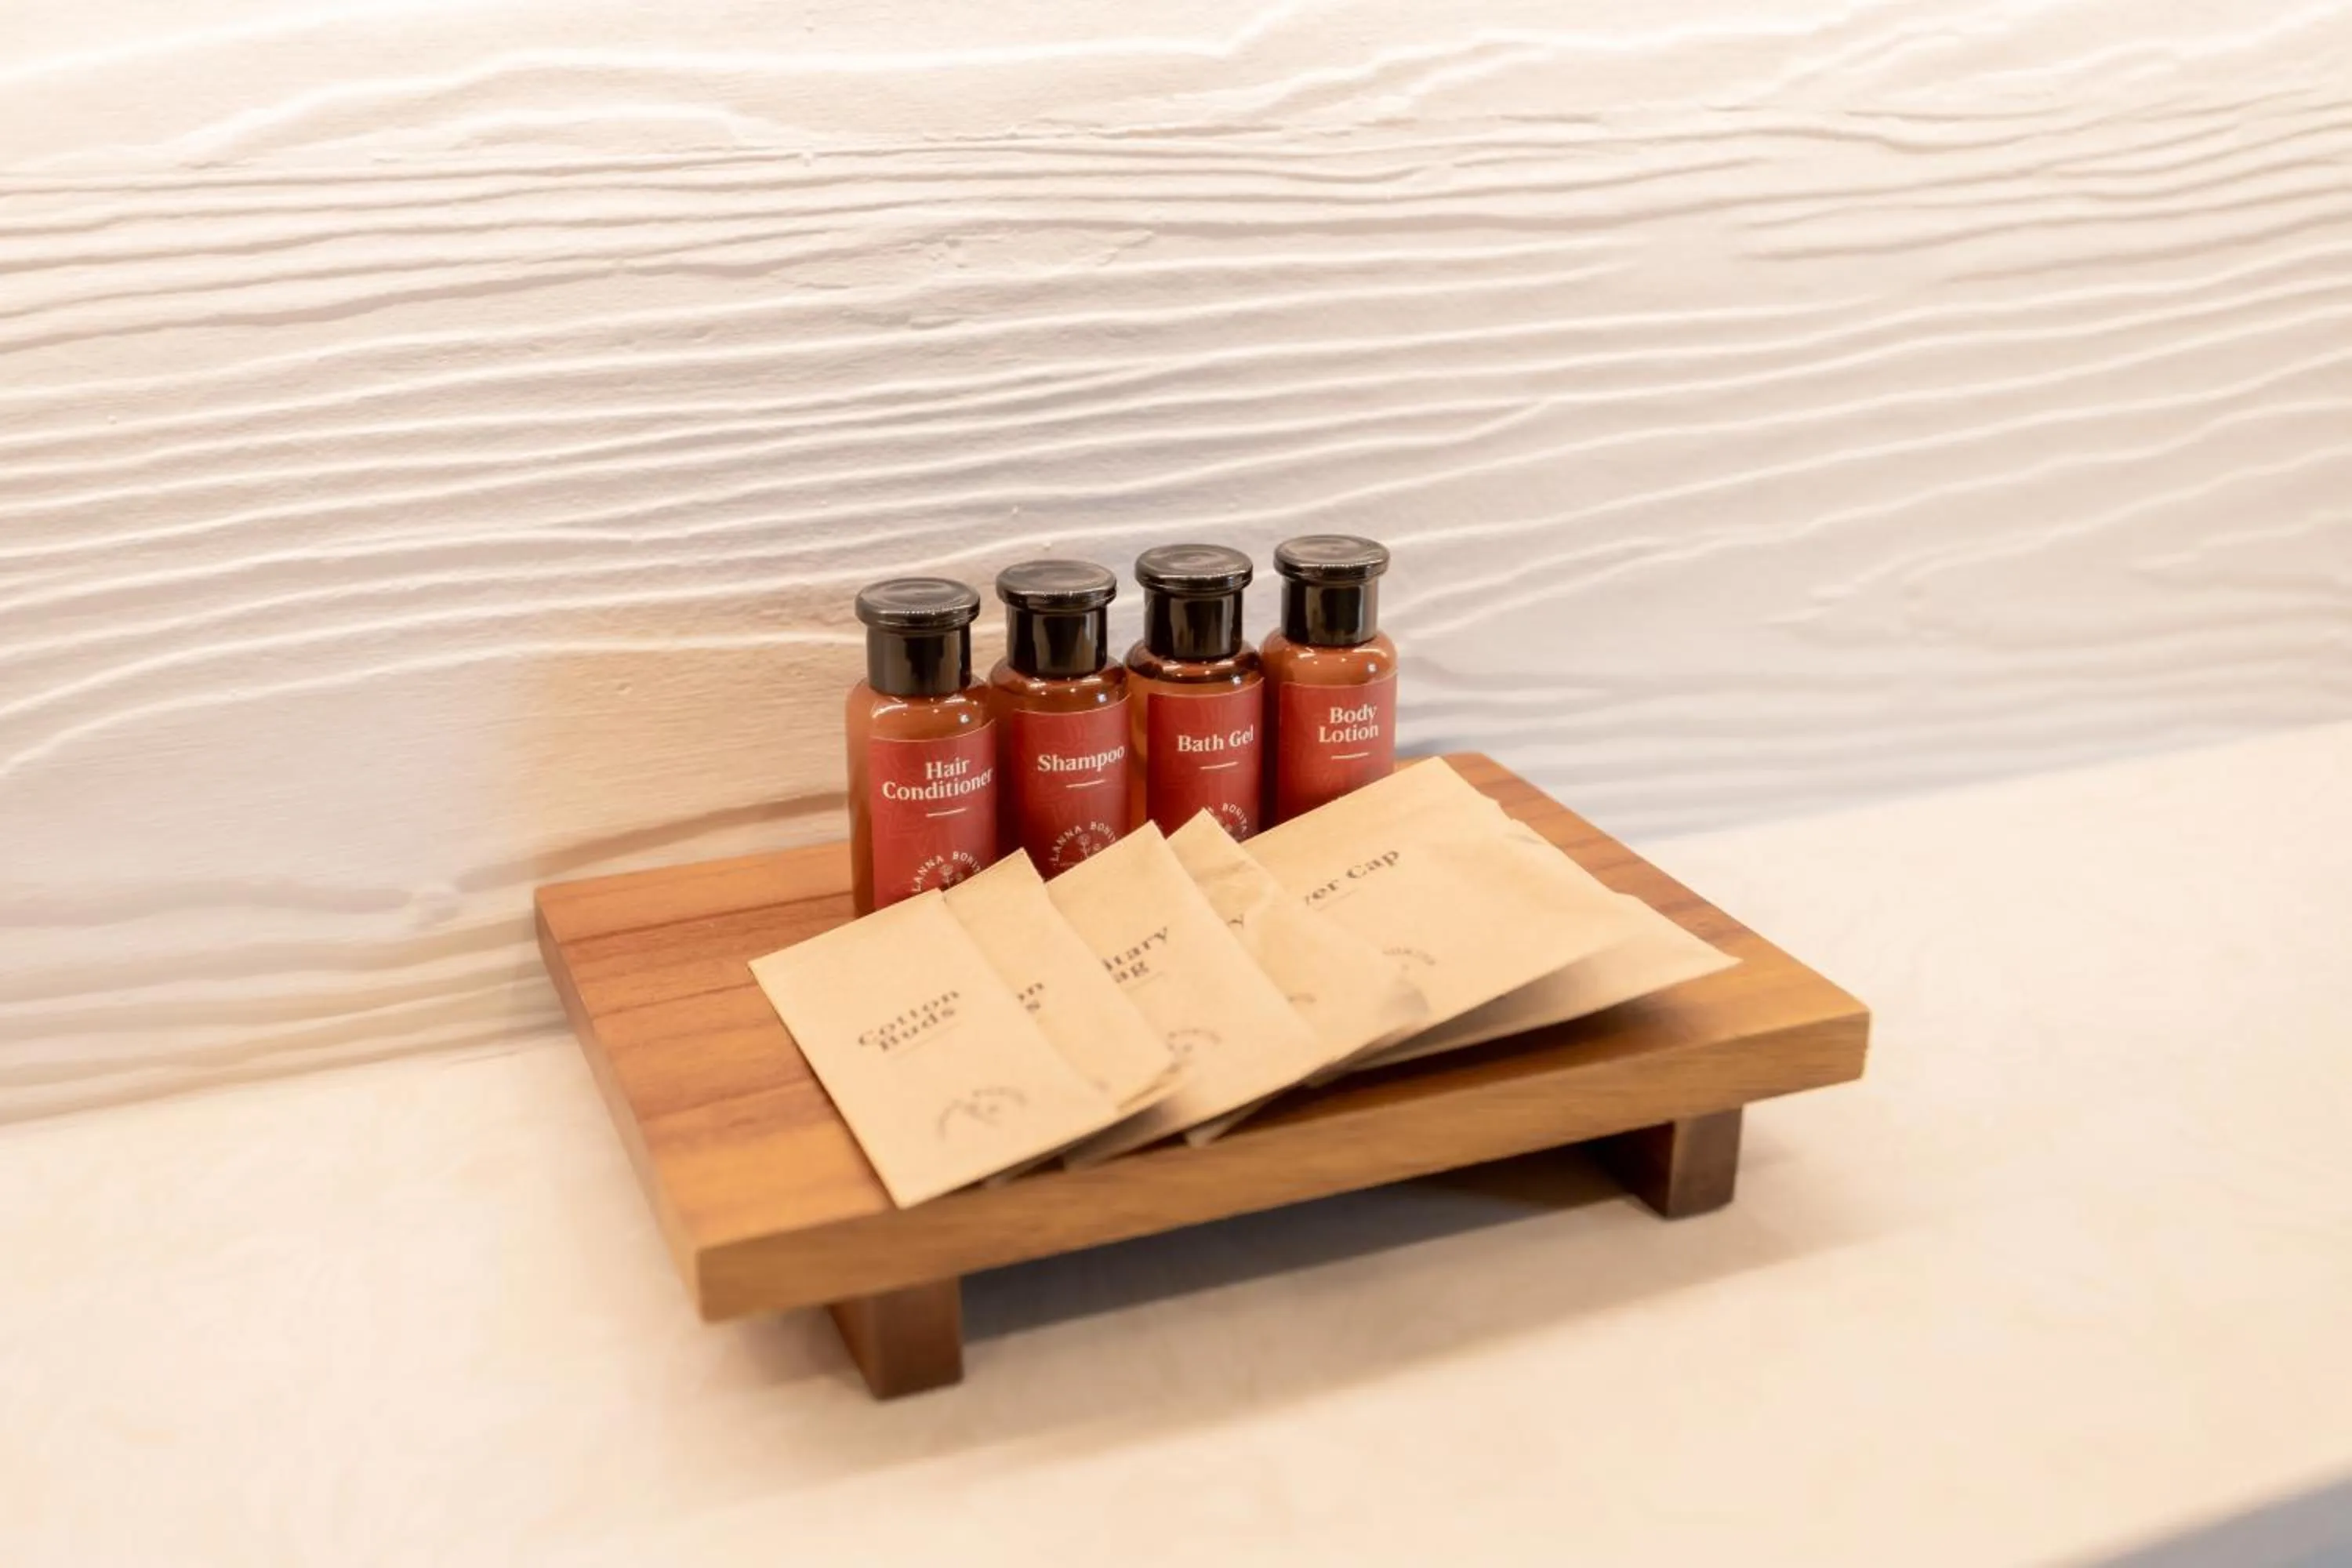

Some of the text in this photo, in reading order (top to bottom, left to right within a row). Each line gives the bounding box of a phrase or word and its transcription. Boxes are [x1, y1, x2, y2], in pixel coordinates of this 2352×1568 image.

[1330, 703, 1377, 724] Body
[1178, 724, 1254, 753] Bath Gel
[1319, 724, 1379, 743] Lotion
[925, 757, 971, 780] Hair
[1037, 746, 1125, 773] Shampoo
[882, 768, 993, 800] Conditioner
[1049, 824, 1083, 862] LANNA
[911, 855, 944, 891] LANNA
[1345, 850, 1399, 879] Cap
[857, 989, 960, 1047] Cotton
